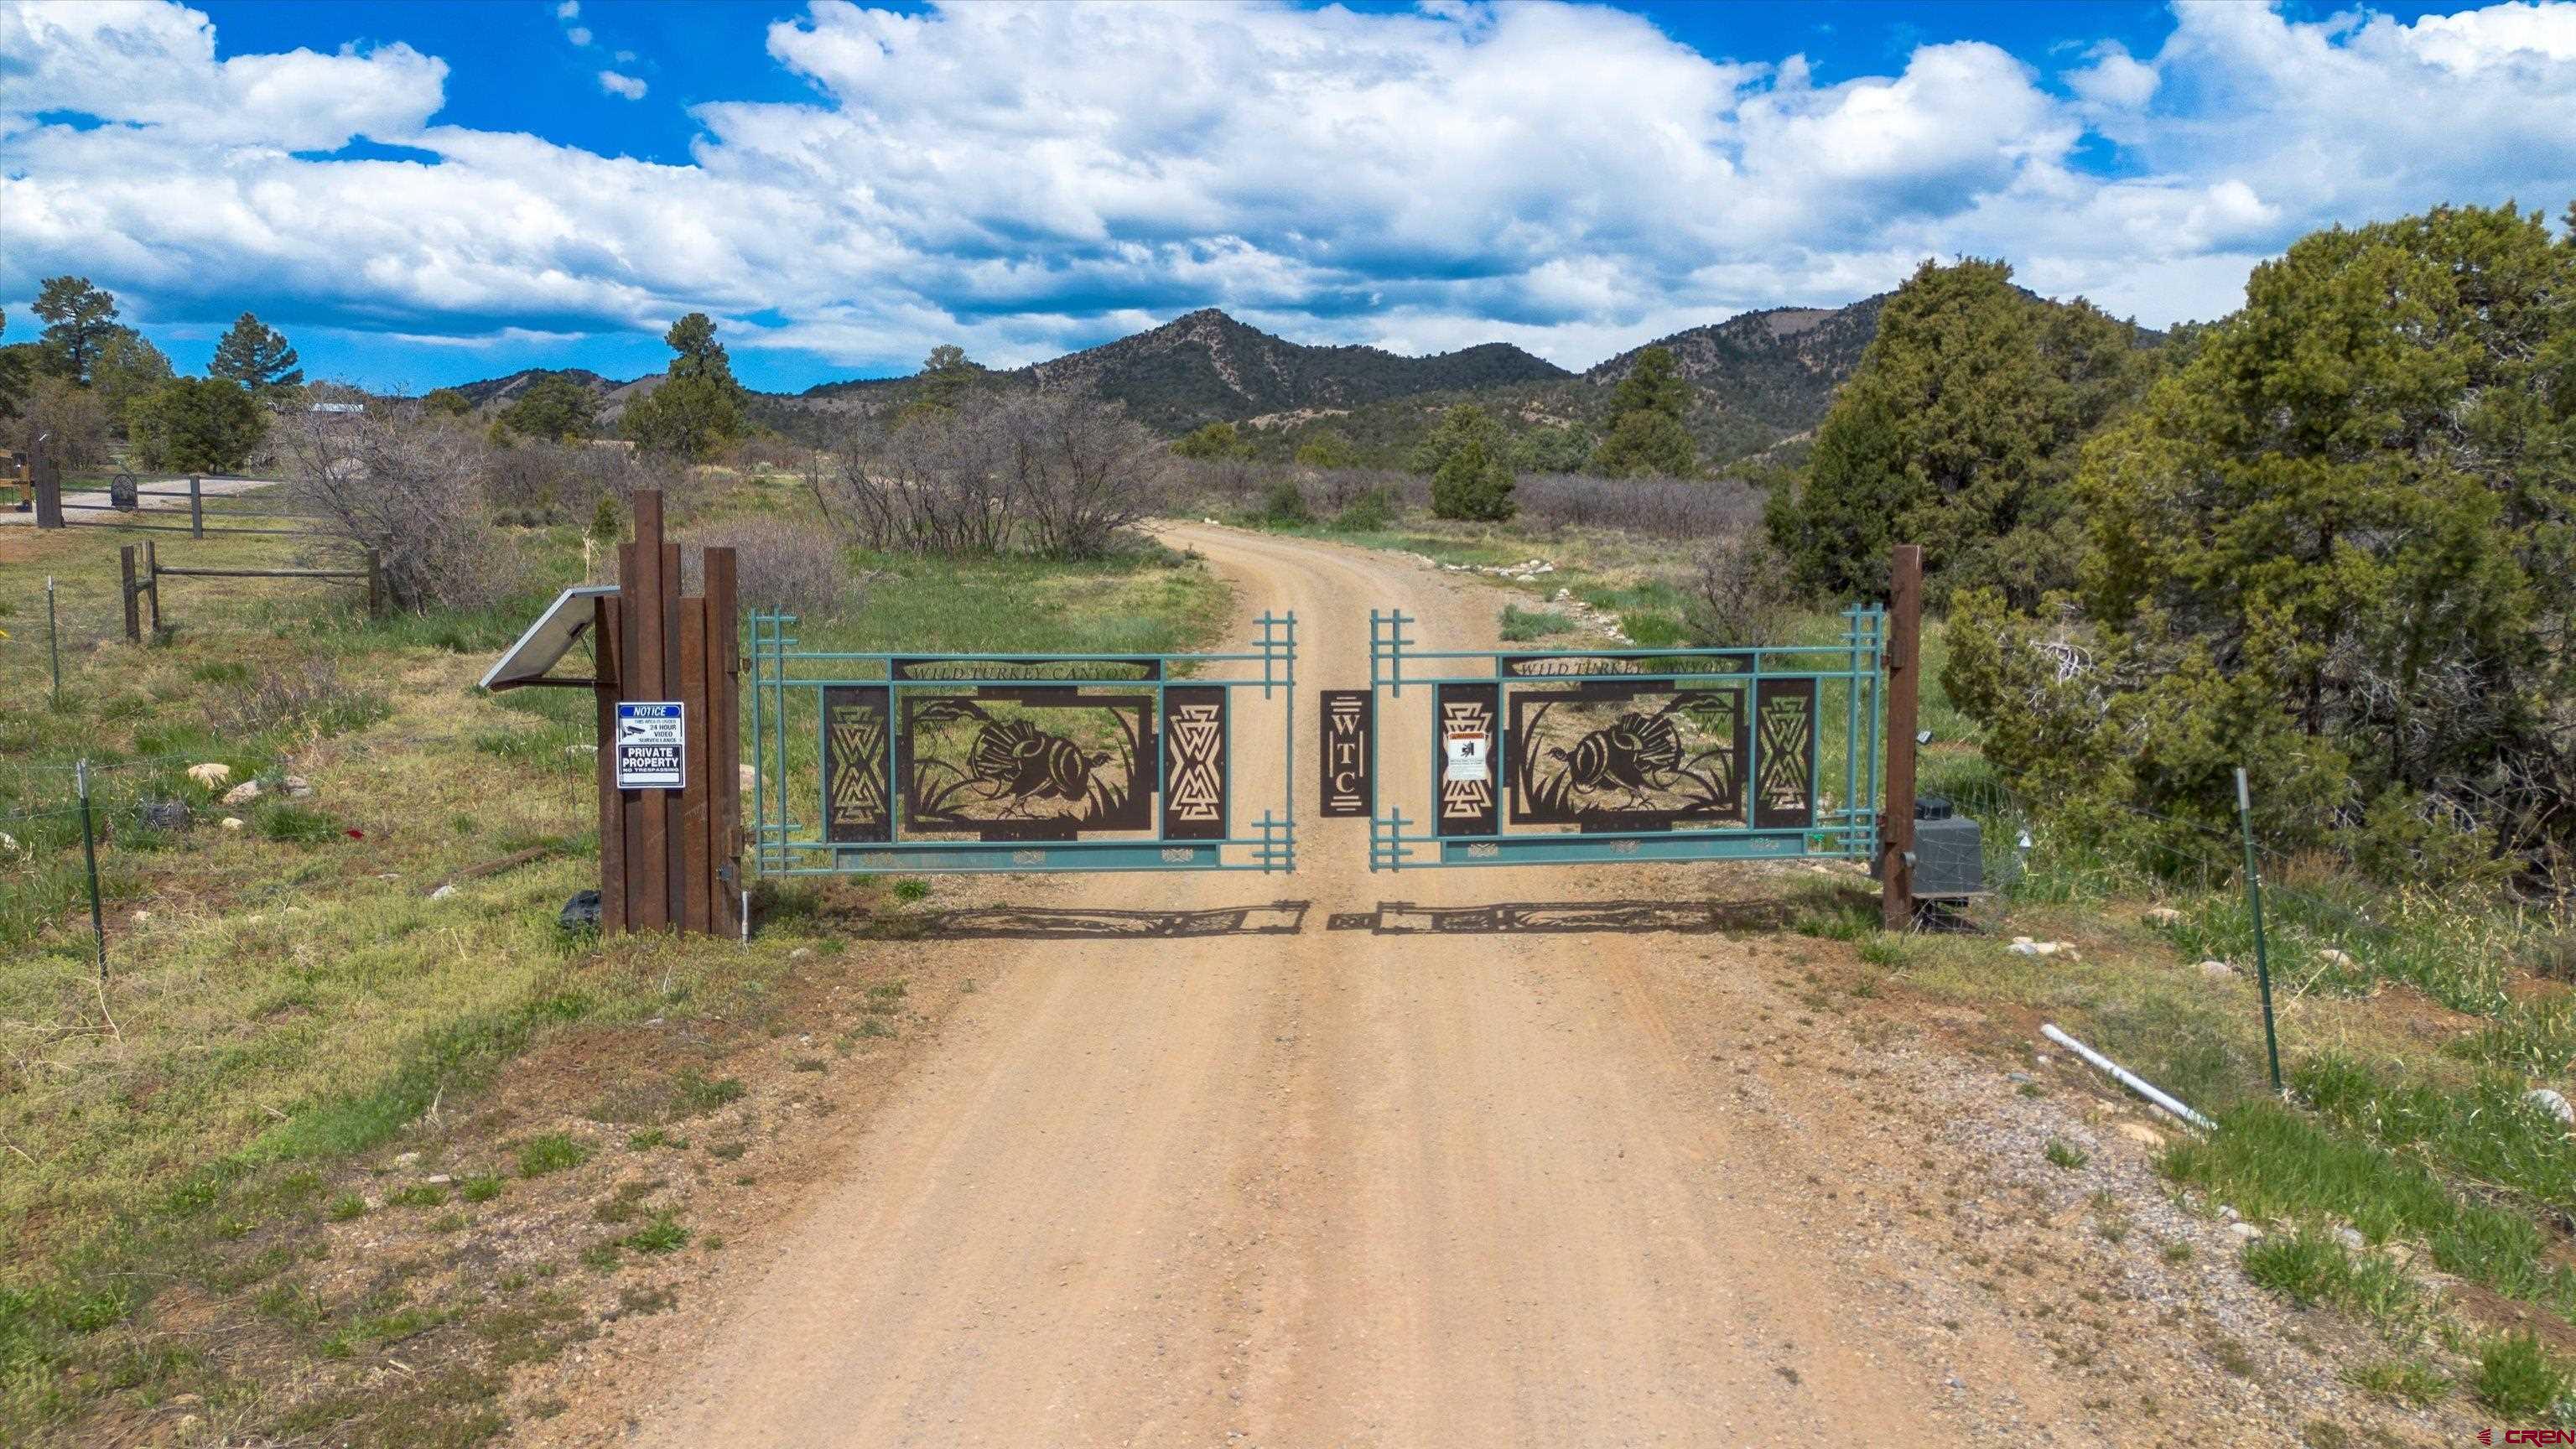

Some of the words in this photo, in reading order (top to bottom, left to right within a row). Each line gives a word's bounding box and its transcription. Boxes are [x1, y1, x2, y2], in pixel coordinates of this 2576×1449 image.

[912, 667, 964, 679] WILD
[971, 667, 1046, 679] TURKEY
[1052, 667, 1130, 679] CANYON
[1521, 663, 1568, 675] WILD
[1576, 662, 1644, 675] TURKEY
[634, 706, 667, 716] NOTICE
[628, 748, 673, 757] PRIVATE
[623, 758, 679, 767] PROPERTY
